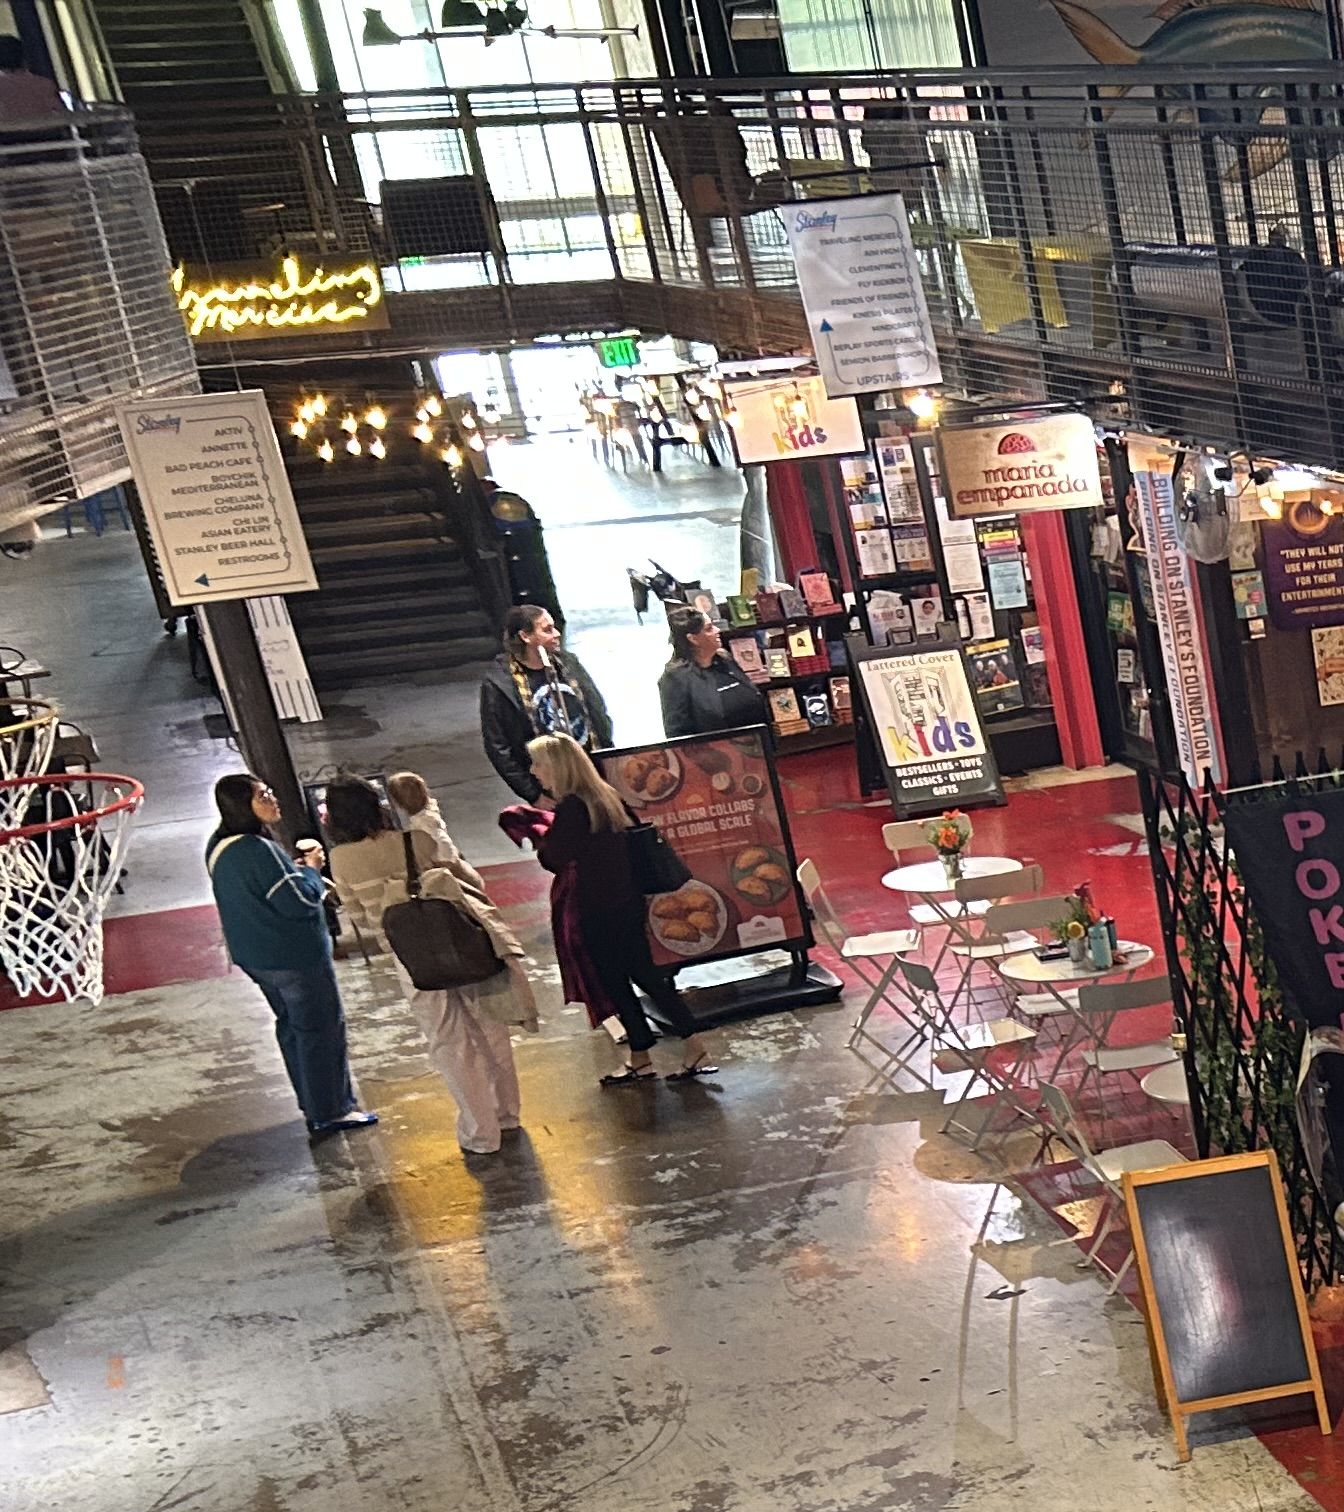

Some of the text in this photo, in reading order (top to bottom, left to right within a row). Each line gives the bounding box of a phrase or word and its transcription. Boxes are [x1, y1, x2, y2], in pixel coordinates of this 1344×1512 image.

[600, 339, 636, 366] EXIT
[856, 372, 910, 386] UPSTAIRS
[214, 426, 242, 437] AKTIV
[772, 424, 828, 455] kids
[202, 442, 248, 454] ANNETTE
[165, 464, 188, 474] BAD
[190, 460, 224, 470] PEACH
[982, 459, 1057, 484] maria
[171, 480, 259, 496] MEDITERRANEAN
[957, 474, 1089, 508] empanada
[164, 502, 264, 520] BREWING COMPANY
[201, 524, 272, 539] ASIAN EATERY
[174, 537, 276, 556] STANLEY BEER HALL
[1307, 546, 1327, 557] WILL
[1328, 543, 1344, 554] NOT
[218, 552, 280, 566] RESTROOMS
[1284, 558, 1344, 574] USE MY TEARS
[1296, 573, 1336, 586] FOR THEIR
[1153, 478, 1178, 552] BUILDING
[1166, 556, 1182, 578] ON
[1182, 664, 1212, 761] FOUNDATION
[918, 652, 954, 665] Cover
[887, 716, 976, 761] kids
[895, 757, 982, 778] BESTSELLERS TOYS
[901, 769, 984, 789] CLASSICS EVENTS
[932, 784, 958, 796] GIFTS
[666, 806, 707, 824] FLAVOR
[708, 798, 756, 817] COLLABS
[677, 820, 718, 838] GLOBAL
[718, 814, 752, 830] SCALE
